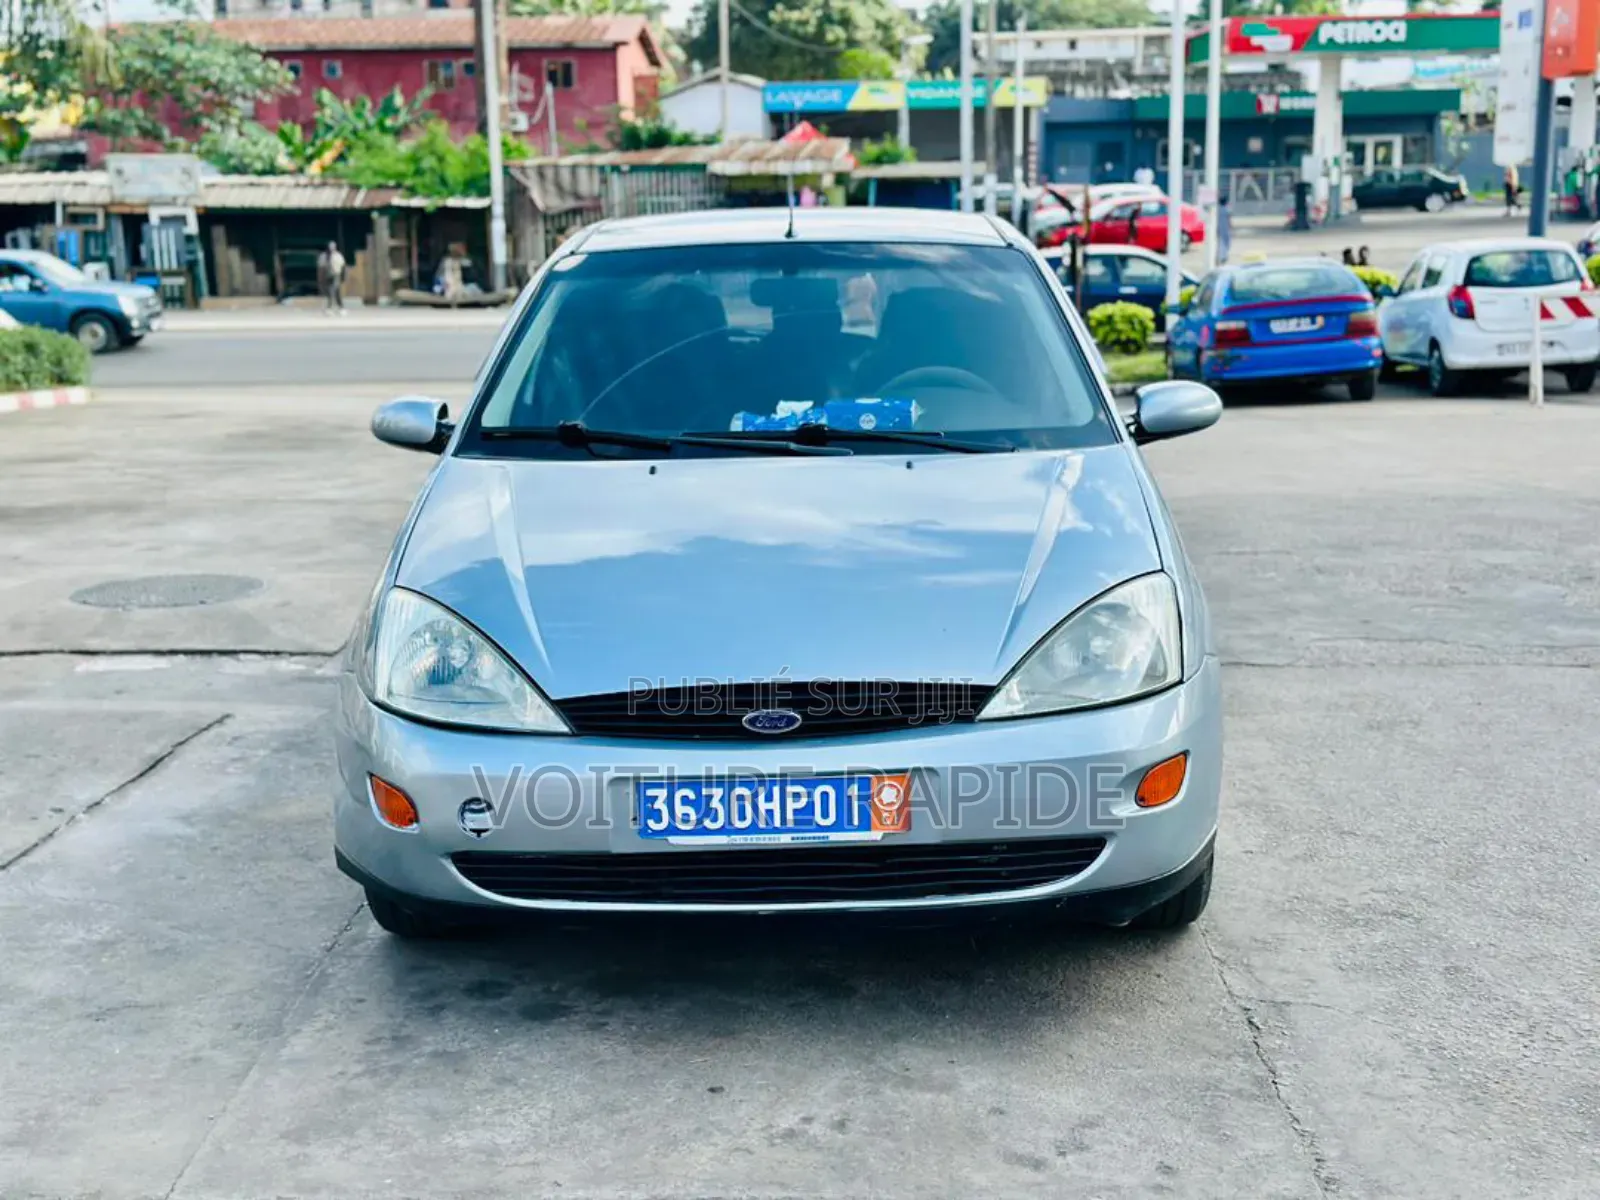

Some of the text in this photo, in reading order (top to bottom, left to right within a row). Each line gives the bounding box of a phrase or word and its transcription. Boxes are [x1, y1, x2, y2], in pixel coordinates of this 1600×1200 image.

[1318, 21, 1407, 45] PETROCI
[766, 89, 842, 103] LAVAGE
[906, 86, 986, 99] VIDANE
[753, 713, 790, 728] Ford
